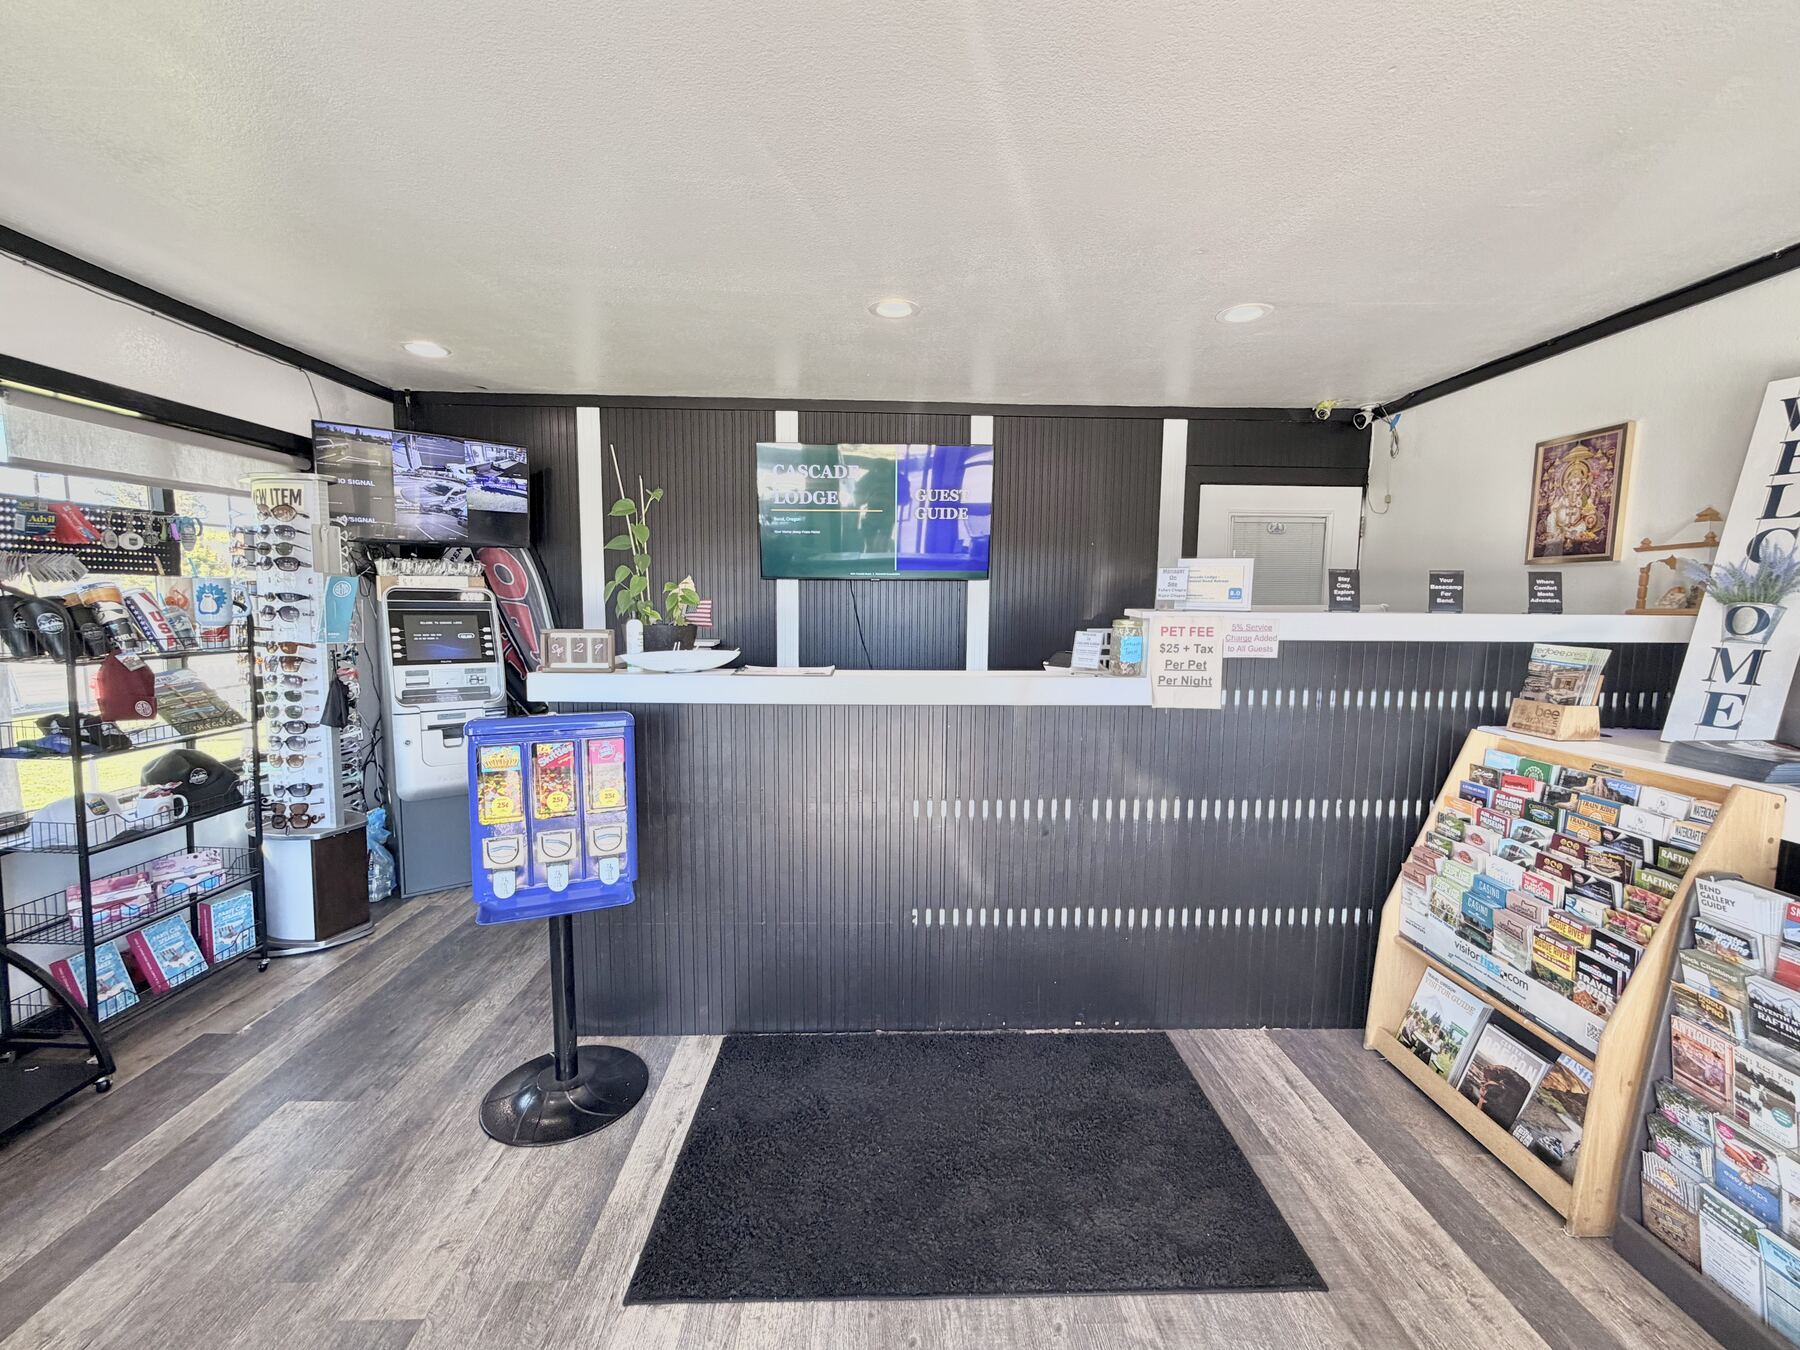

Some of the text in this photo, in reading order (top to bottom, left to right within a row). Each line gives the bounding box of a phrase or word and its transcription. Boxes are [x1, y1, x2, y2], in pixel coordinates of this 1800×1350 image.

[347, 478, 376, 487] SIGNAL
[270, 488, 303, 506] ITEM
[773, 489, 839, 505] LODGE
[915, 489, 969, 502] GUEST
[29, 514, 56, 524] Advil
[351, 516, 377, 524] SIGNAL
[915, 507, 969, 520] GUIDE
[1160, 626, 1214, 638] PET FEE
[1246, 624, 1273, 633] Service
[1225, 634, 1278, 643] Charge Added
[573, 642, 584, 654] 2
[1160, 644, 1180, 655] $25
[1194, 644, 1214, 654] Tax
[1248, 646, 1274, 654] Guests
[1164, 659, 1207, 671] Per Pet
[1158, 675, 1213, 688] Per Night
[1535, 704, 1560, 720] bee
[1496, 798, 1522, 811] MUSEUM
[1582, 799, 1617, 815] TRAIN RIDES
[1570, 816, 1586, 826] TRAIN
[1661, 849, 1692, 866] RAFTIN
[1641, 872, 1678, 892] RAFTING
[1698, 882, 1721, 895] BEND
[1478, 880, 1500, 899] CASINO
[1700, 890, 1736, 908] GALLERY
[1701, 898, 1728, 912] GUIDE
[1468, 897, 1489, 917] CASINO
[1548, 916, 1566, 933] ROGUE
[1568, 924, 1585, 942] RIVER
[1534, 935, 1552, 951] ROGUE
[1553, 945, 1570, 962] RIVER
[1700, 961, 1738, 982] Climbing
[1577, 971, 1614, 997] TRAVEL
[1450, 994, 1476, 1013] GUIDE
[1672, 1018, 1726, 1051] ANTIQUES
